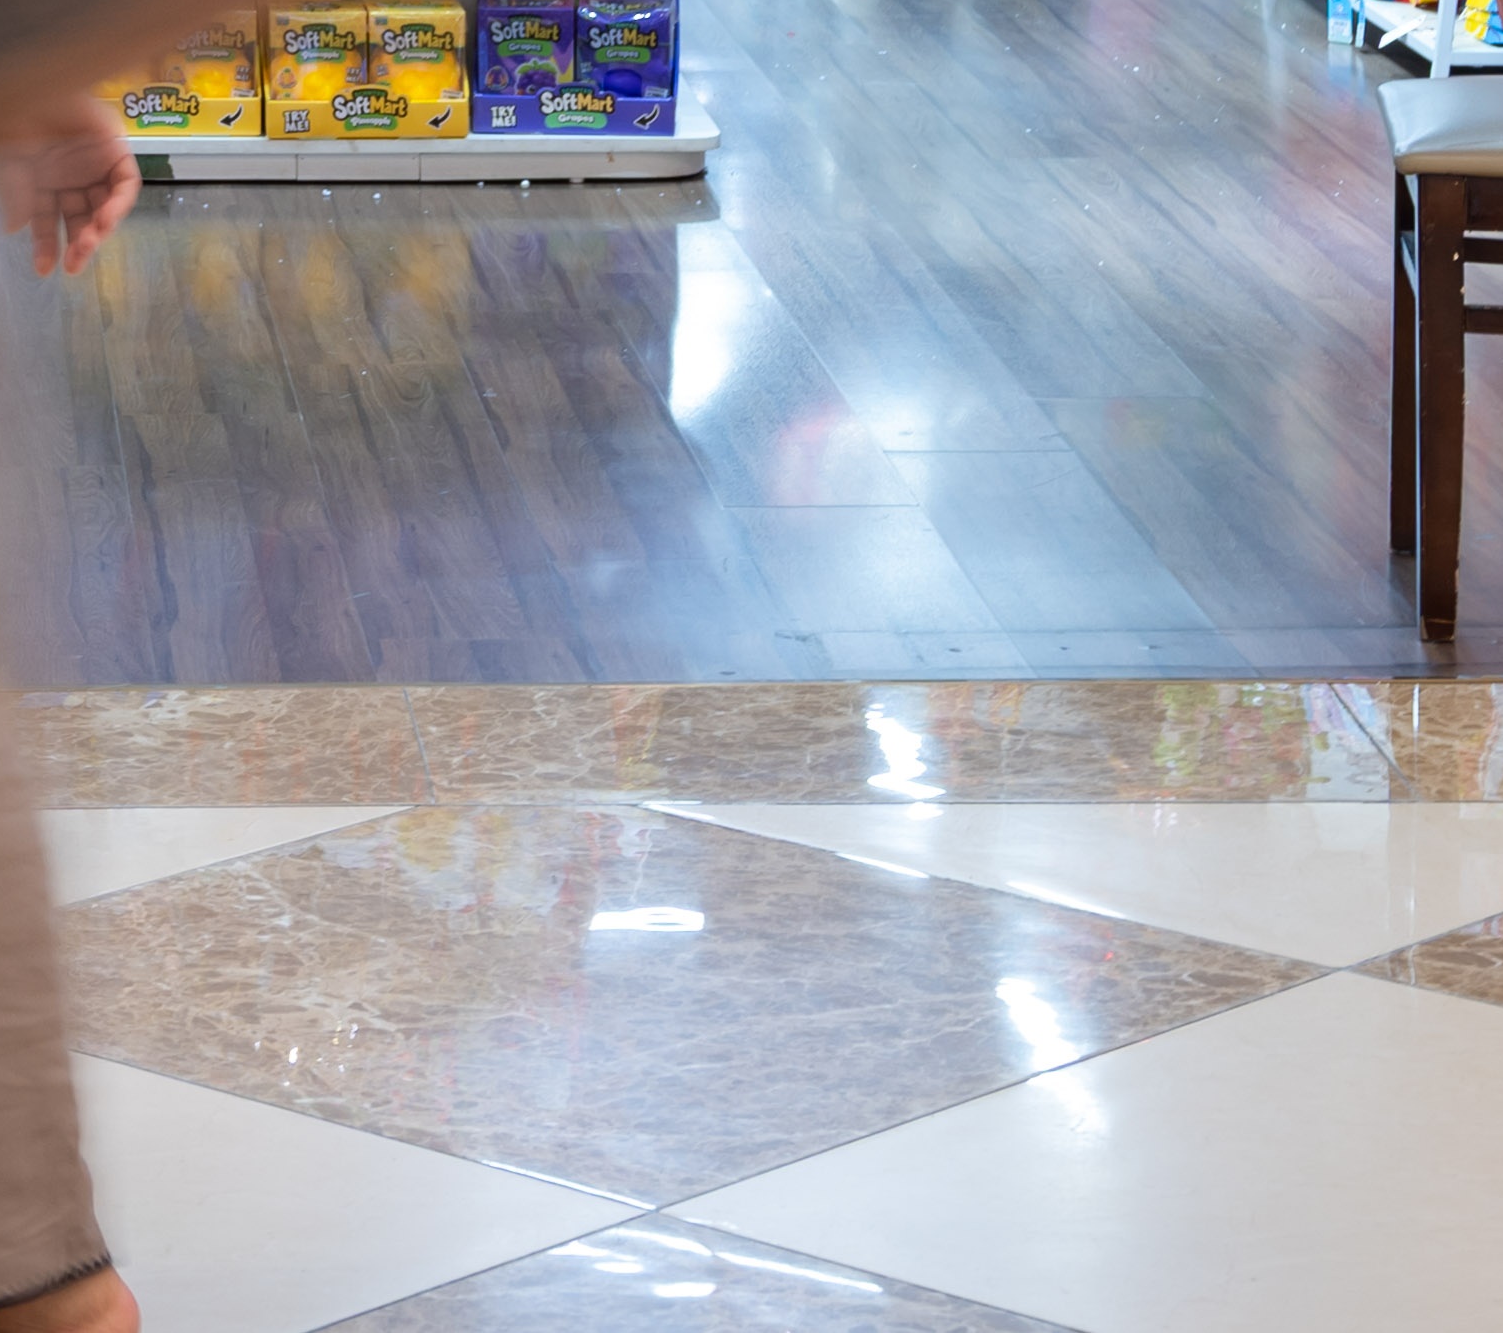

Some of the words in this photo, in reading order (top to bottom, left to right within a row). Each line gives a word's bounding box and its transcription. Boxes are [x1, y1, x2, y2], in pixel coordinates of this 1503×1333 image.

[490, 19, 560, 43] SoftMart
[588, 26, 658, 49] SoftMart
[284, 30, 355, 54] SoftMart
[382, 30, 454, 54] SoftMart
[508, 42, 542, 53] Grapes
[606, 48, 639, 59] Grapes
[124, 92, 199, 118] SoftMart
[333, 95, 408, 121] SoftMart
[490, 105, 516, 117] TRY
[541, 91, 614, 114] SoftMart
[284, 110, 309, 122] TRY
[491, 115, 517, 128] ME!
[557, 113, 595, 124] Grapes
[284, 120, 310, 133] ME!
